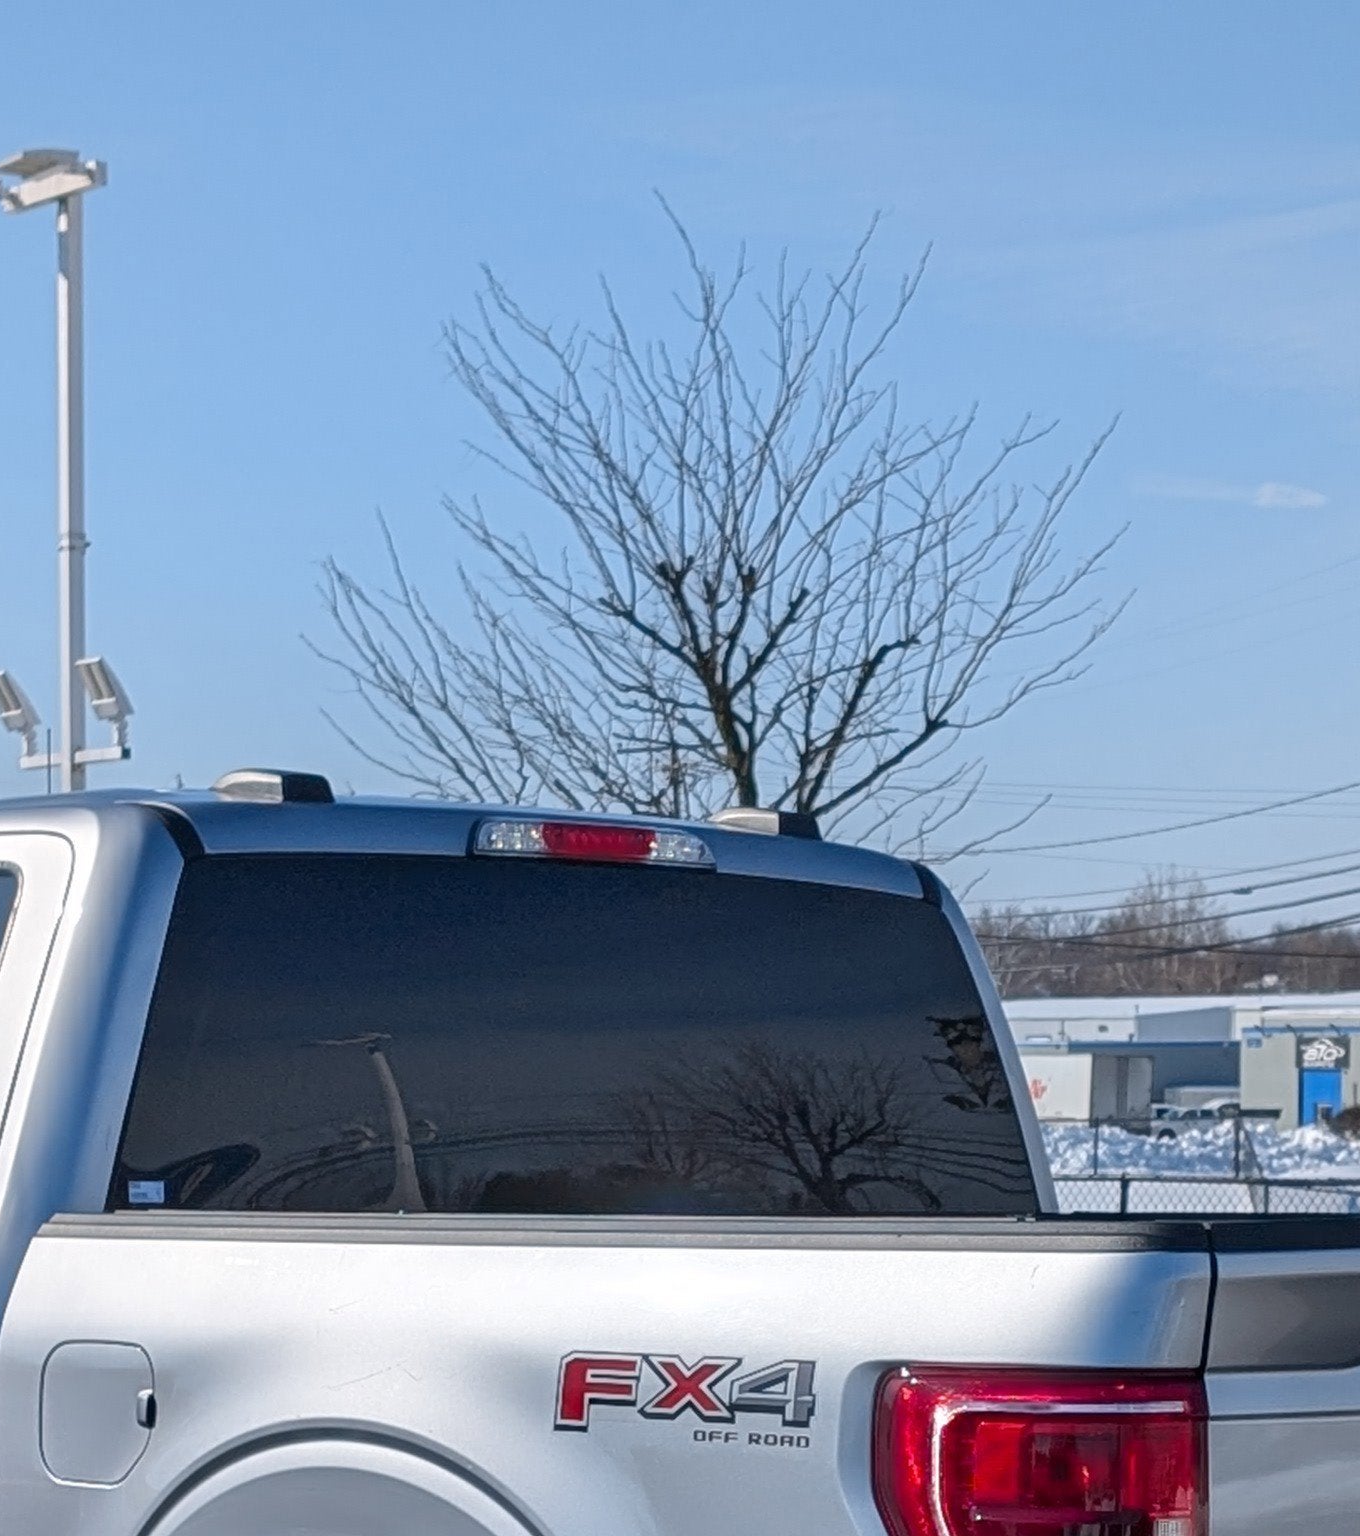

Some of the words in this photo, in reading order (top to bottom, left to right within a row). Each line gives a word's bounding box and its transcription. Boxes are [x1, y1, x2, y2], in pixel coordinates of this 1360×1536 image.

[553, 1350, 816, 1432] FX4
[693, 1430, 738, 1443] OFF
[747, 1432, 810, 1448] ROAD
